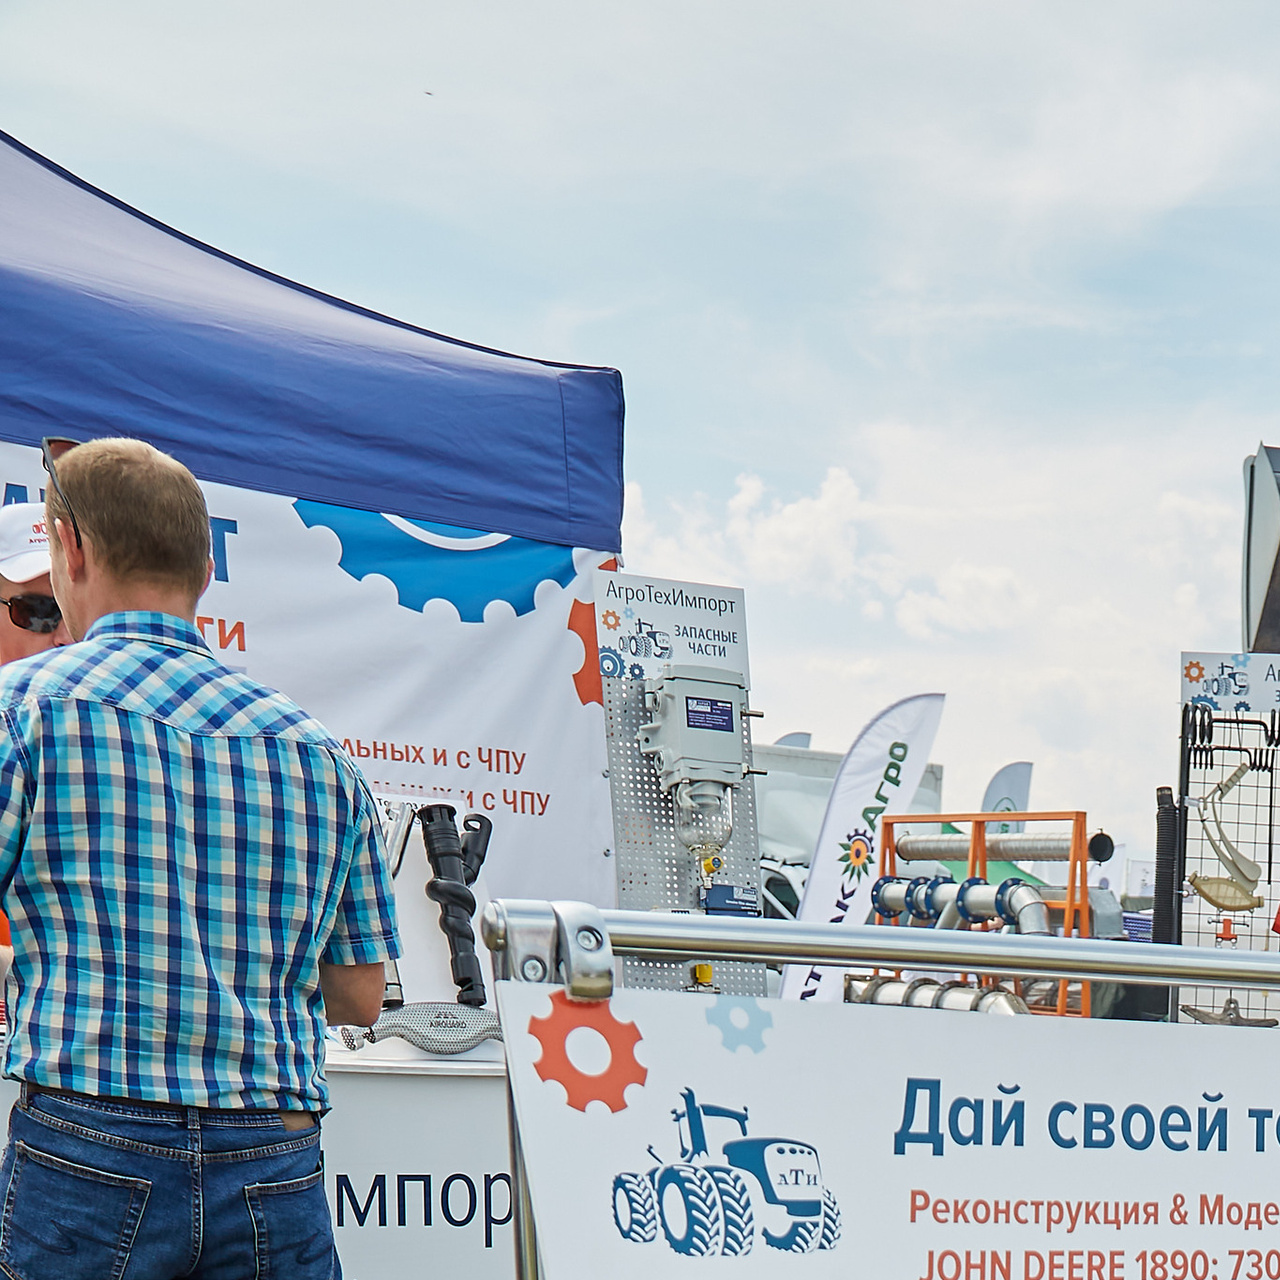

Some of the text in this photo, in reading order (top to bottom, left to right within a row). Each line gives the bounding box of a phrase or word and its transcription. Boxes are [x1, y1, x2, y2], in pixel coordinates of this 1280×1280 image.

[605, 579, 736, 617] АгроТехИмпорт
[674, 624, 739, 644] ЗАПАСНЫЕ
[688, 642, 727, 658] ЧАСТИ
[342, 738, 527, 776] льных и с ЧПУ
[502, 788, 551, 816] ЧПУ
[894, 1077, 1026, 1157] Дай
[1047, 1091, 1228, 1152] своей
[333, 1172, 513, 1249] мпор
[909, 1189, 1159, 1234] Реконструкция
[1169, 1193, 1189, 1226] &
